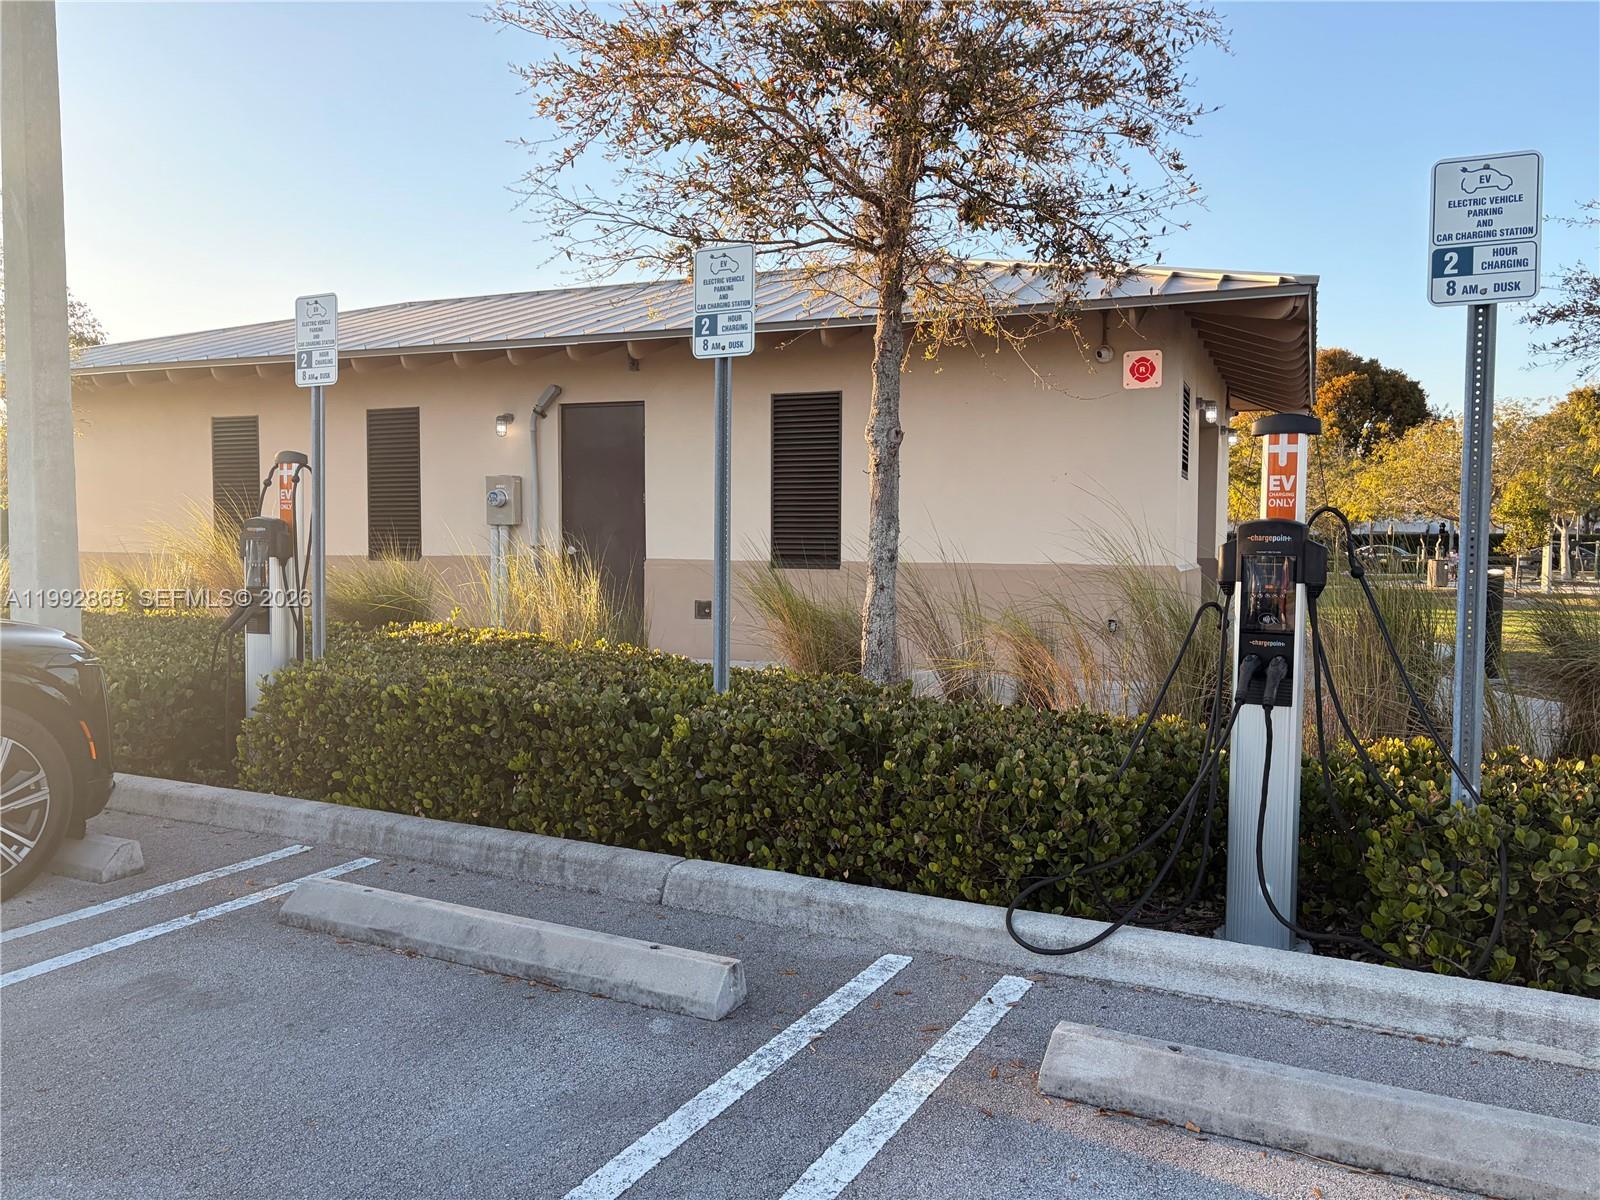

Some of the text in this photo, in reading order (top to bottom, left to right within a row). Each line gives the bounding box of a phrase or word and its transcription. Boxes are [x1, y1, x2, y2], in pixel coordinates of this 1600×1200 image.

[1479, 174, 1492, 184] EV
[1448, 194, 1524, 209] ELECTRIC VEHICLE
[1467, 207, 1503, 218] PARKING
[1476, 219, 1494, 228] AND
[1436, 226, 1534, 243] CAR CHARGING STATION
[1492, 247, 1518, 257] HOUR
[720, 260, 728, 268] EV
[1443, 252, 1459, 275] 2
[1481, 258, 1529, 271] CHARGING
[703, 275, 745, 286] ELECTRIC VEHICLE
[713, 285, 734, 293] PARKING
[1446, 280, 1521, 296] 8 AM DUSK
[708, 301, 730, 310] CHARGING
[731, 299, 751, 307] STATION
[727, 314, 742, 322] HOUR
[701, 318, 710, 335] 2
[721, 323, 748, 332] CHARGING
[702, 339, 744, 351] 8 AM DUSK
[301, 354, 307, 367] 2
[302, 371, 306, 380] 8
[1269, 474, 1295, 491] EV
[280, 488, 292, 500] EV
[1268, 498, 1295, 508] ONLY
